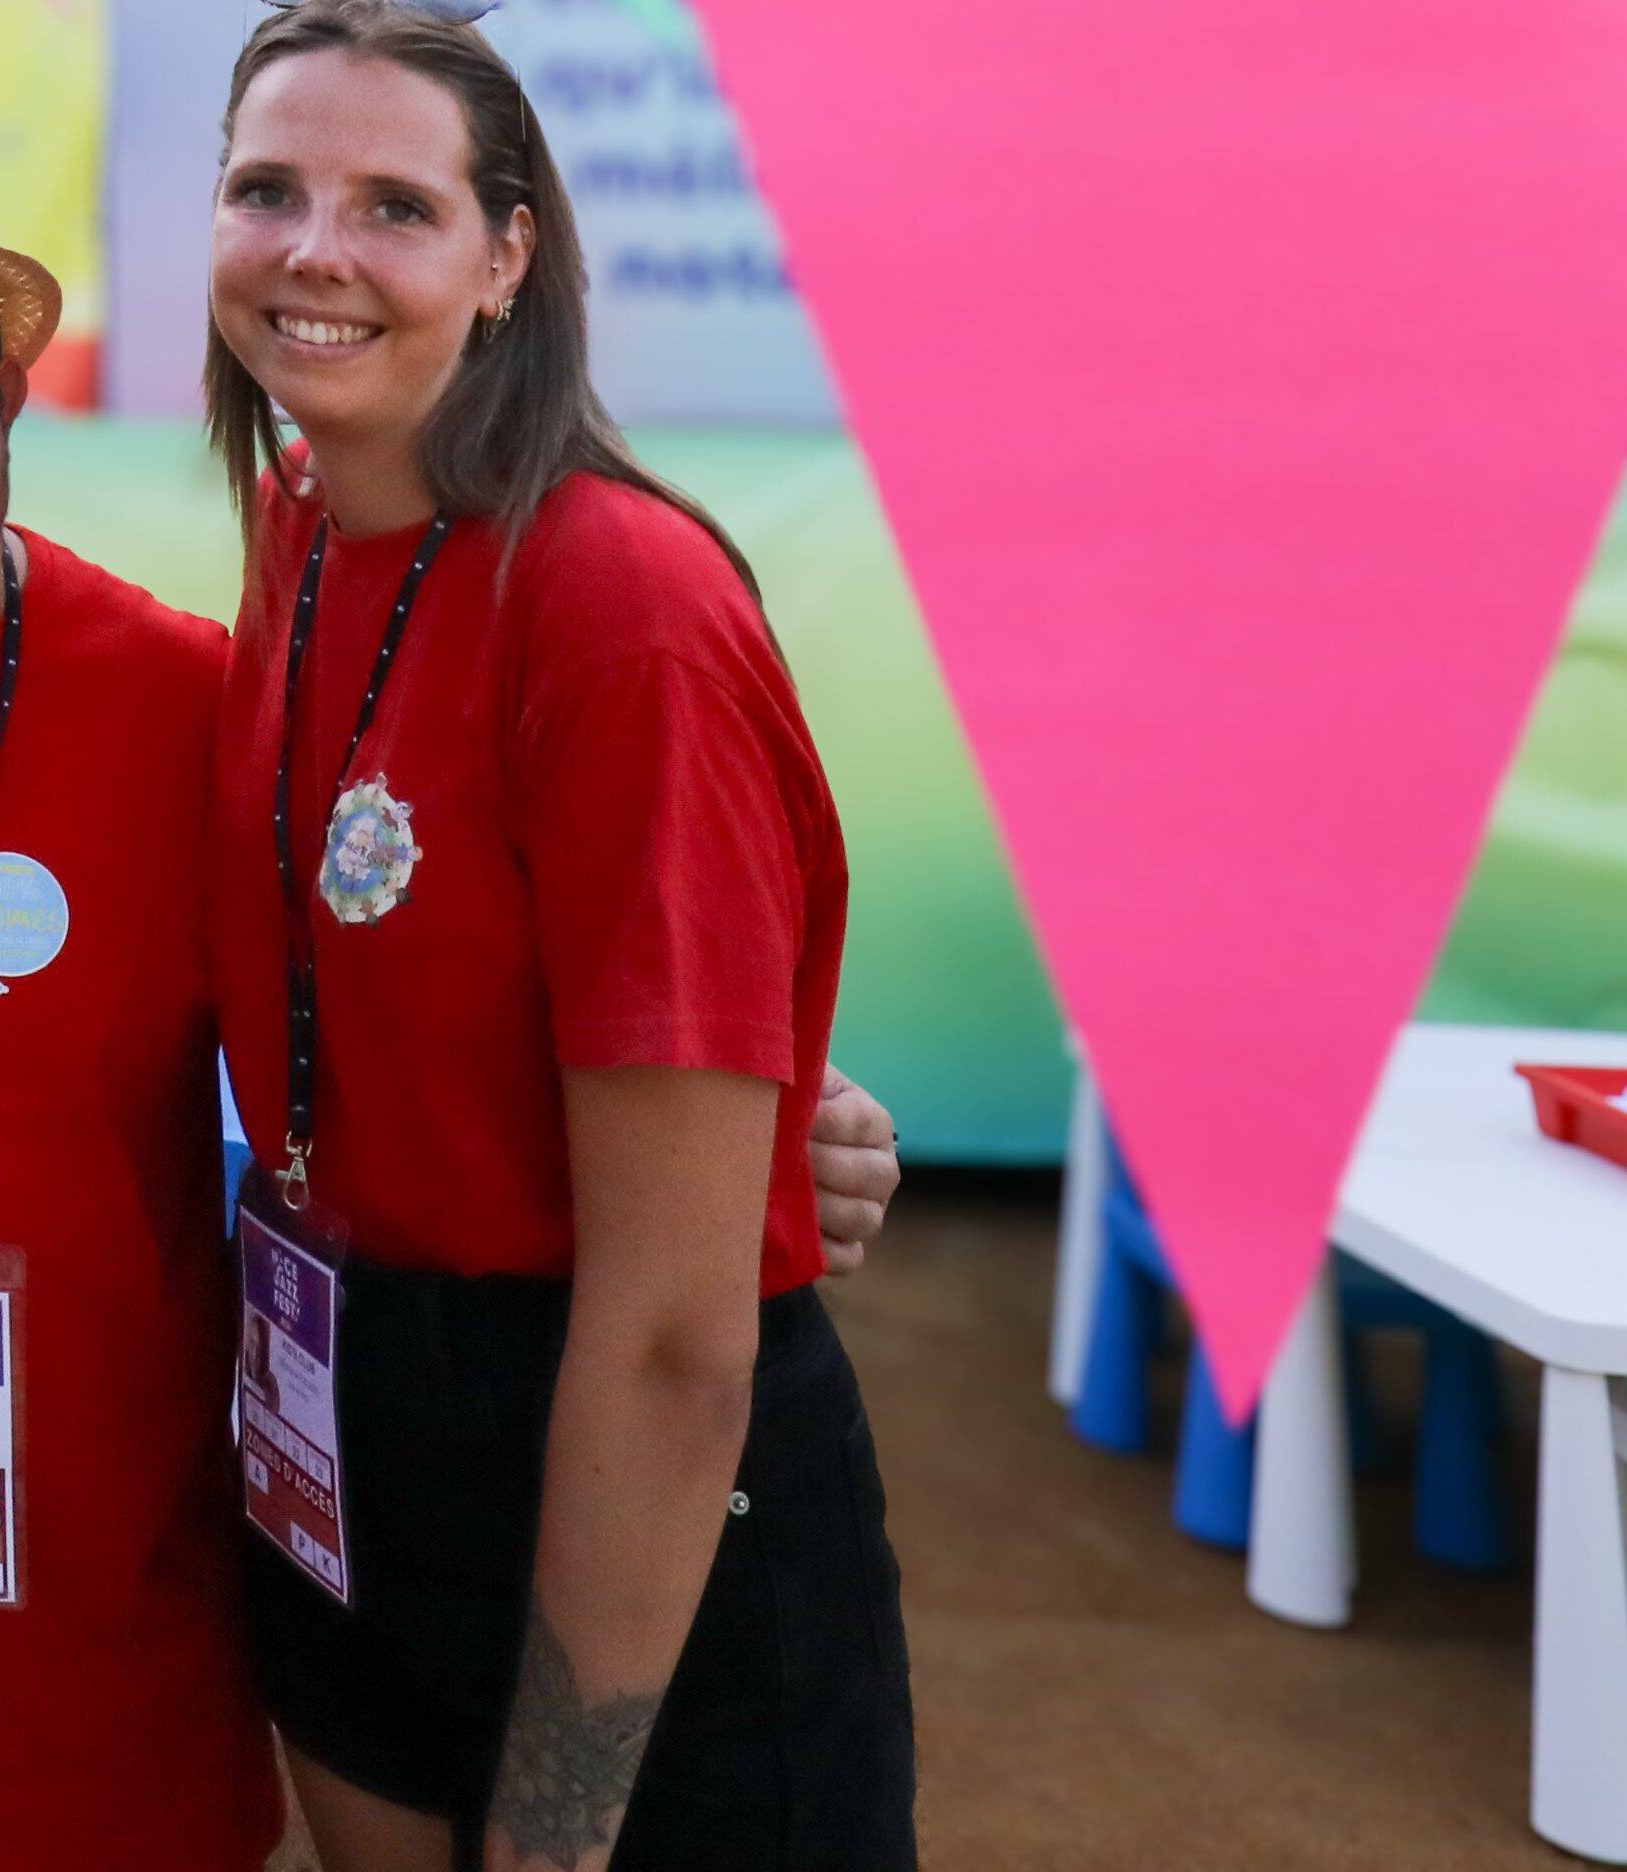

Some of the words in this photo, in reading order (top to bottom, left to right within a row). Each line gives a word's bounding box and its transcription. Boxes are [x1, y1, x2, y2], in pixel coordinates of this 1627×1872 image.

[254, 1463, 262, 1482] A
[297, 1533, 306, 1550] P
[322, 1554, 332, 1574] K
